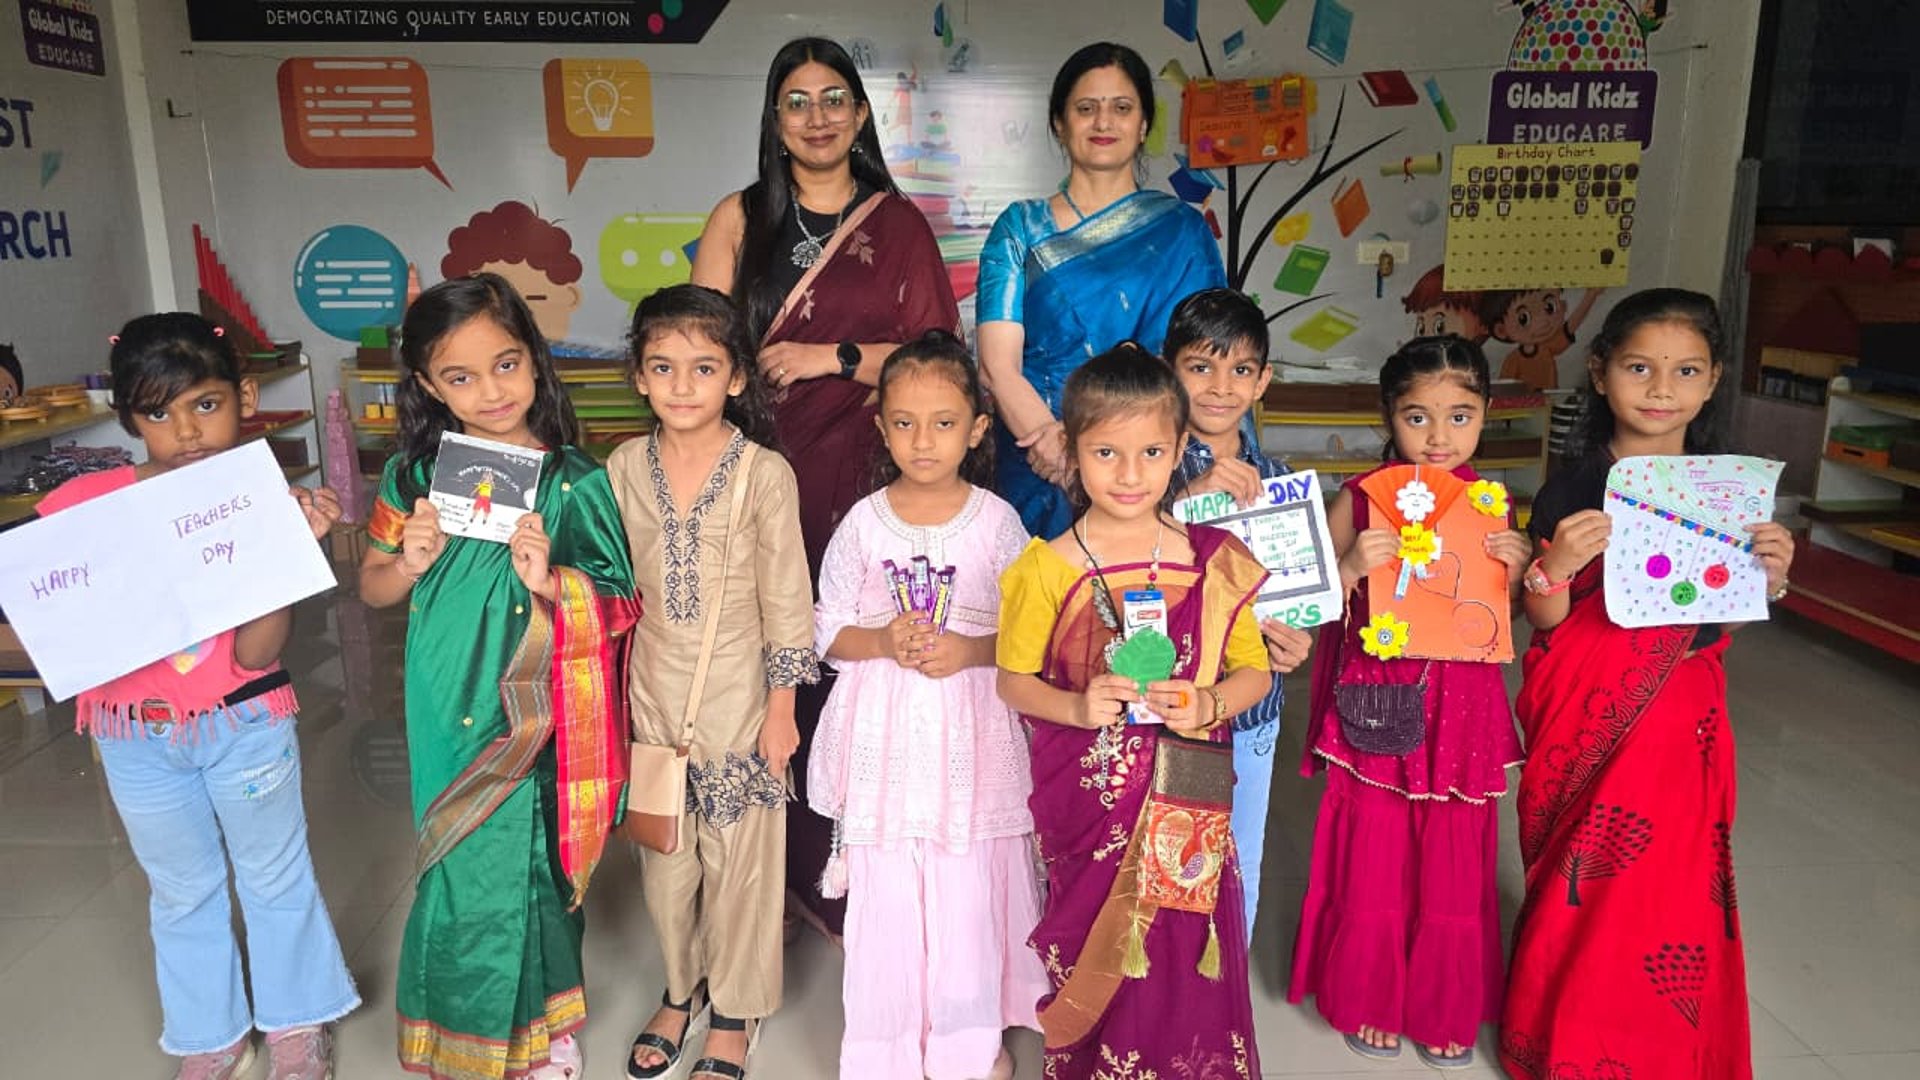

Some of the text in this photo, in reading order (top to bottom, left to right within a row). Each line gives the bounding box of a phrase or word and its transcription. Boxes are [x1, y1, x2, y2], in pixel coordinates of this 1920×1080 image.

[28, 8, 66, 37] Global
[266, 9, 630, 27] DEMOCRATIZING QUALITY EARLY EDUCATION
[1507, 81, 1640, 109] Global Kidz
[1513, 123, 1627, 143] EDUCARE
[1497, 146, 1596, 164] Birthday Chart
[1184, 475, 1312, 522] HAPP DAY
[170, 495, 252, 539] TEACHER'S
[202, 540, 235, 565] DAY
[30, 563, 91, 601] HAPPY
